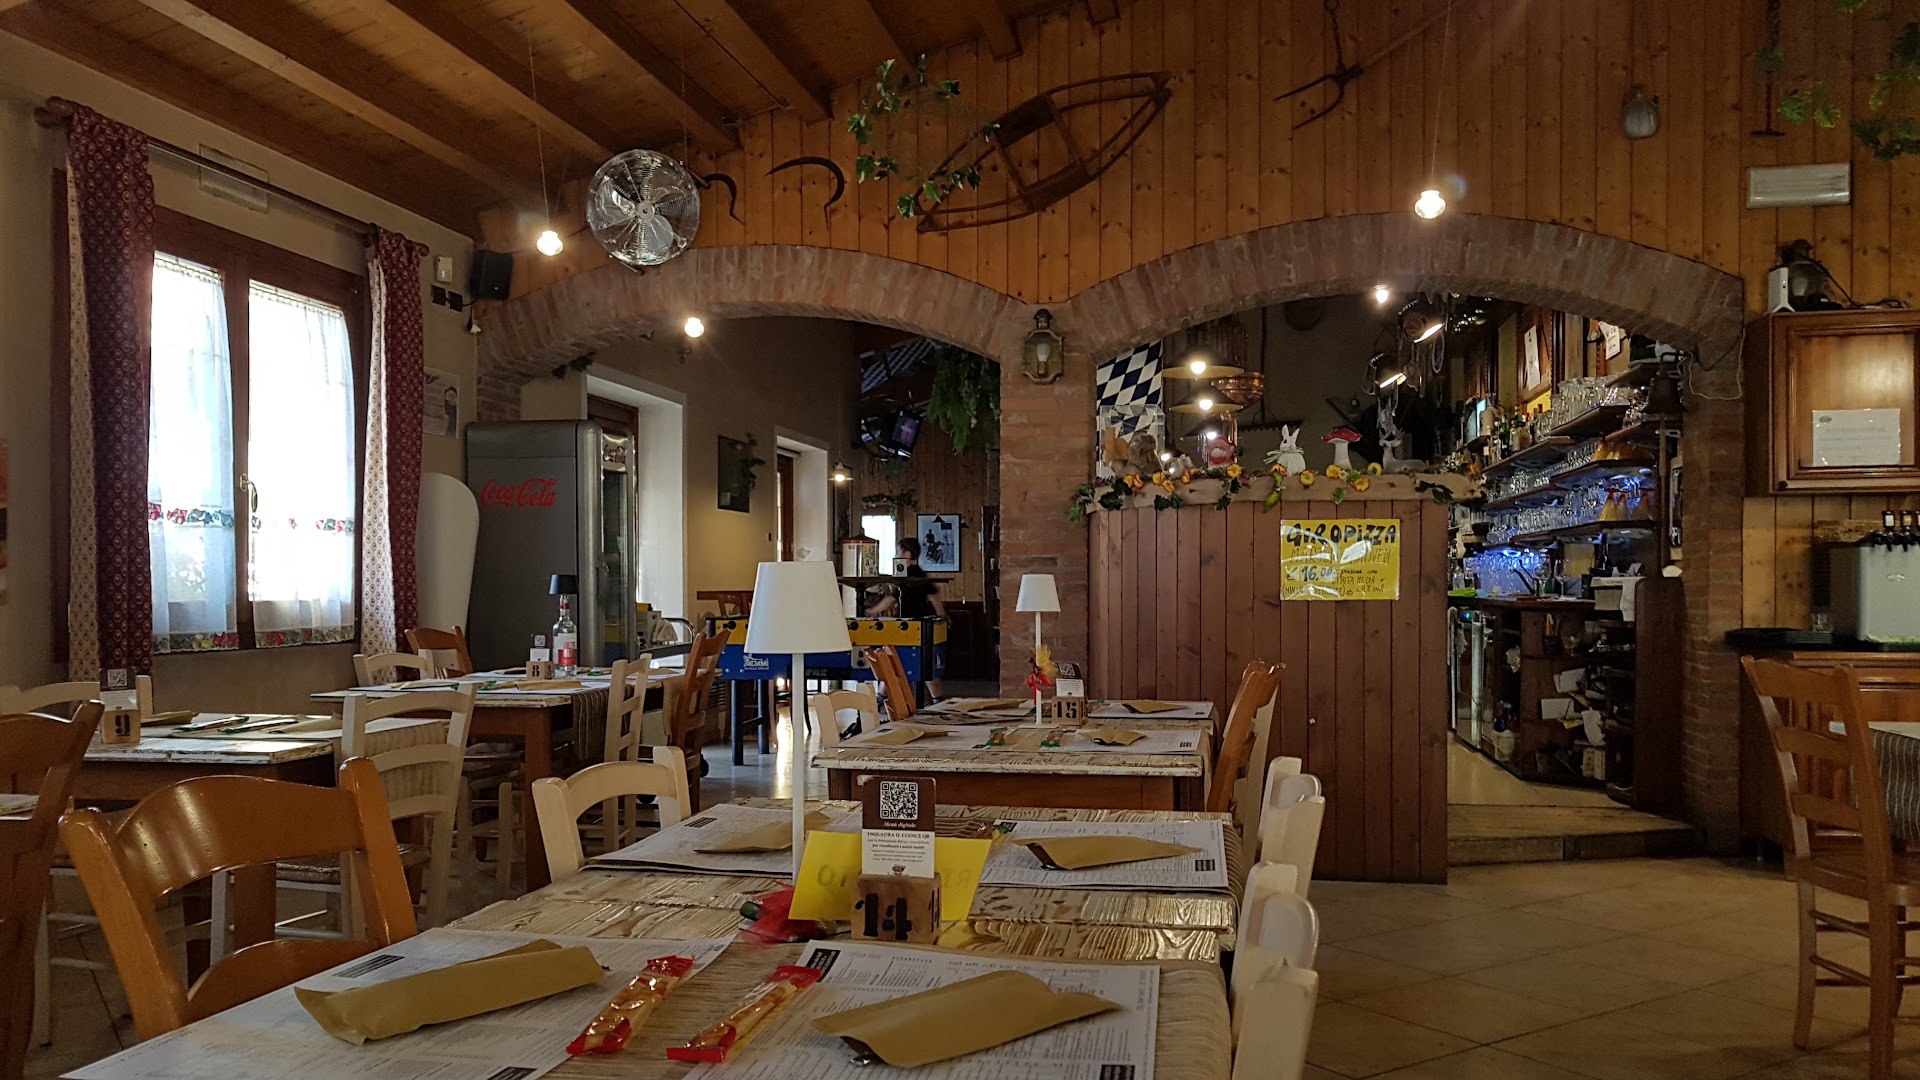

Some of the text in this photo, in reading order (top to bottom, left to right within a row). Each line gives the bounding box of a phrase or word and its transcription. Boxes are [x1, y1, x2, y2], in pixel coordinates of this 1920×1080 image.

[480, 477, 557, 509] Coca-Cola
[1053, 701, 1077, 719] 15
[115, 714, 131, 736] 9
[855, 893, 912, 941] 14
